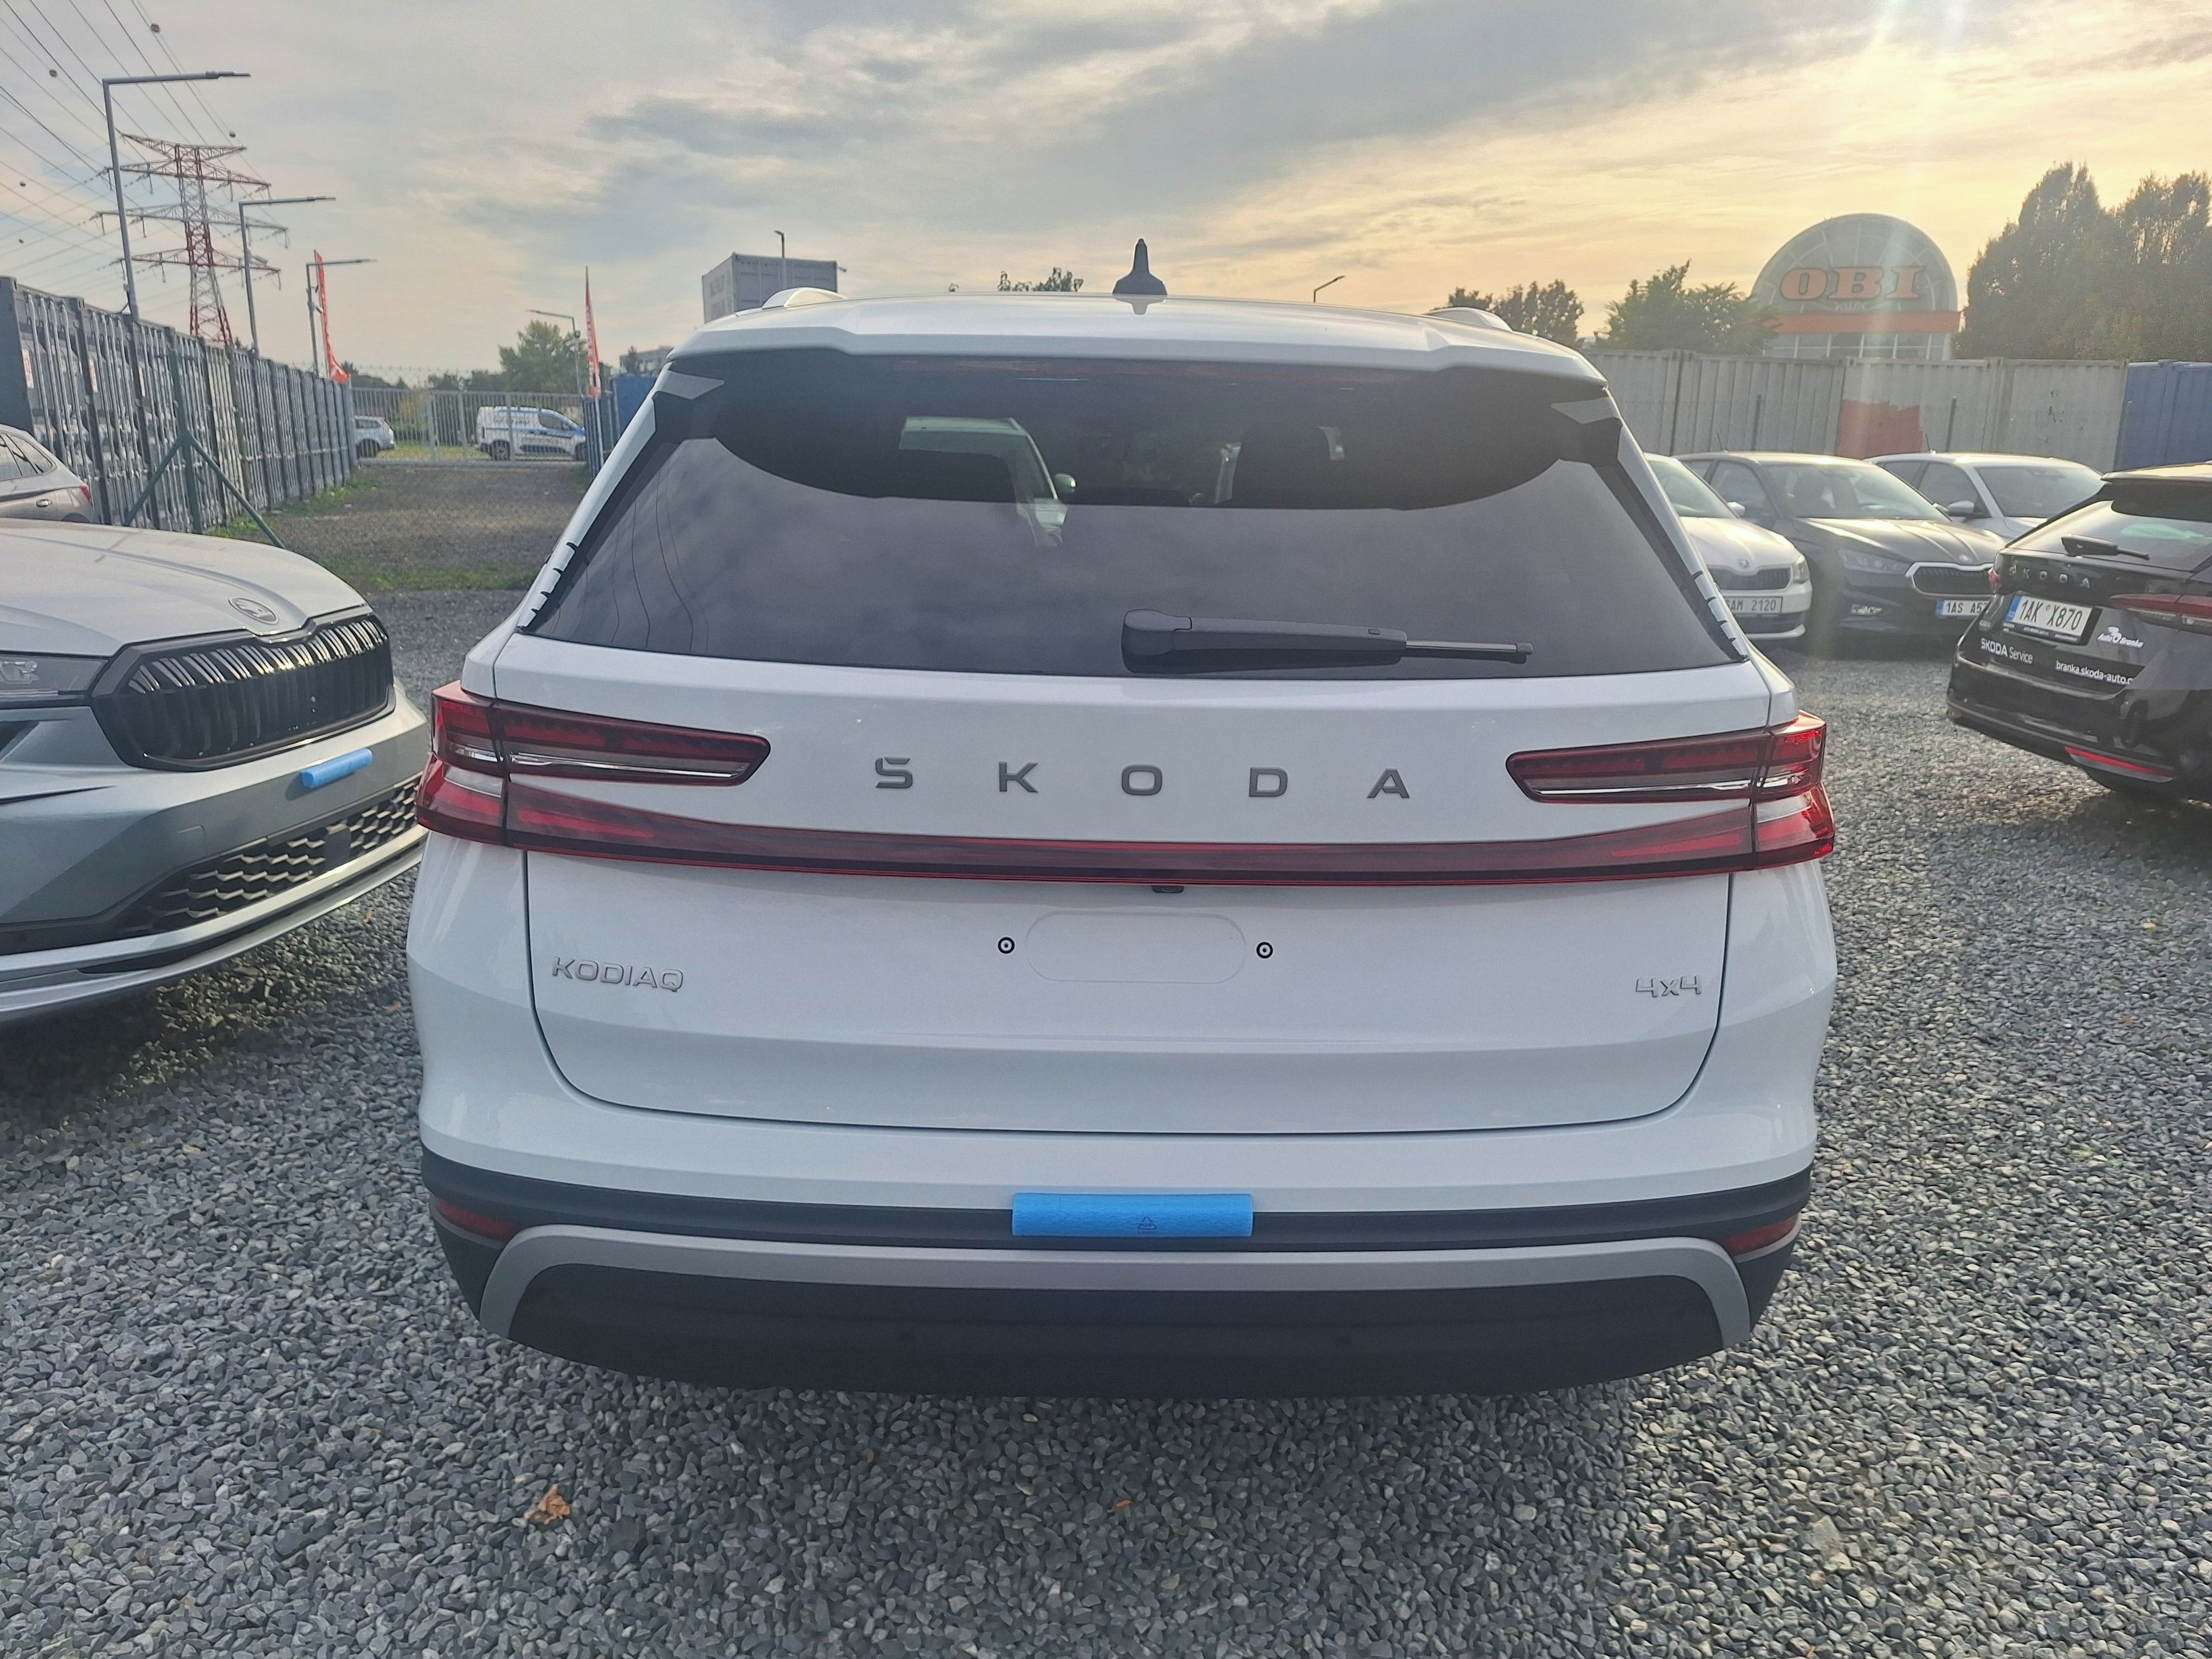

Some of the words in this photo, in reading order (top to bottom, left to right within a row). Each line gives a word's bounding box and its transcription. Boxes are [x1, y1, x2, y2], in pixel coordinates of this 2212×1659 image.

[1780, 266, 1926, 301] OBI
[1751, 599, 1777, 611] 2120
[1946, 601, 1964, 614] 1AS
[2019, 600, 2043, 622] 1AK
[2047, 605, 2083, 631] X870
[2009, 646, 2034, 665] Service
[552, 956, 684, 993] KODIAQ
[1635, 975, 1701, 998] 4x4
